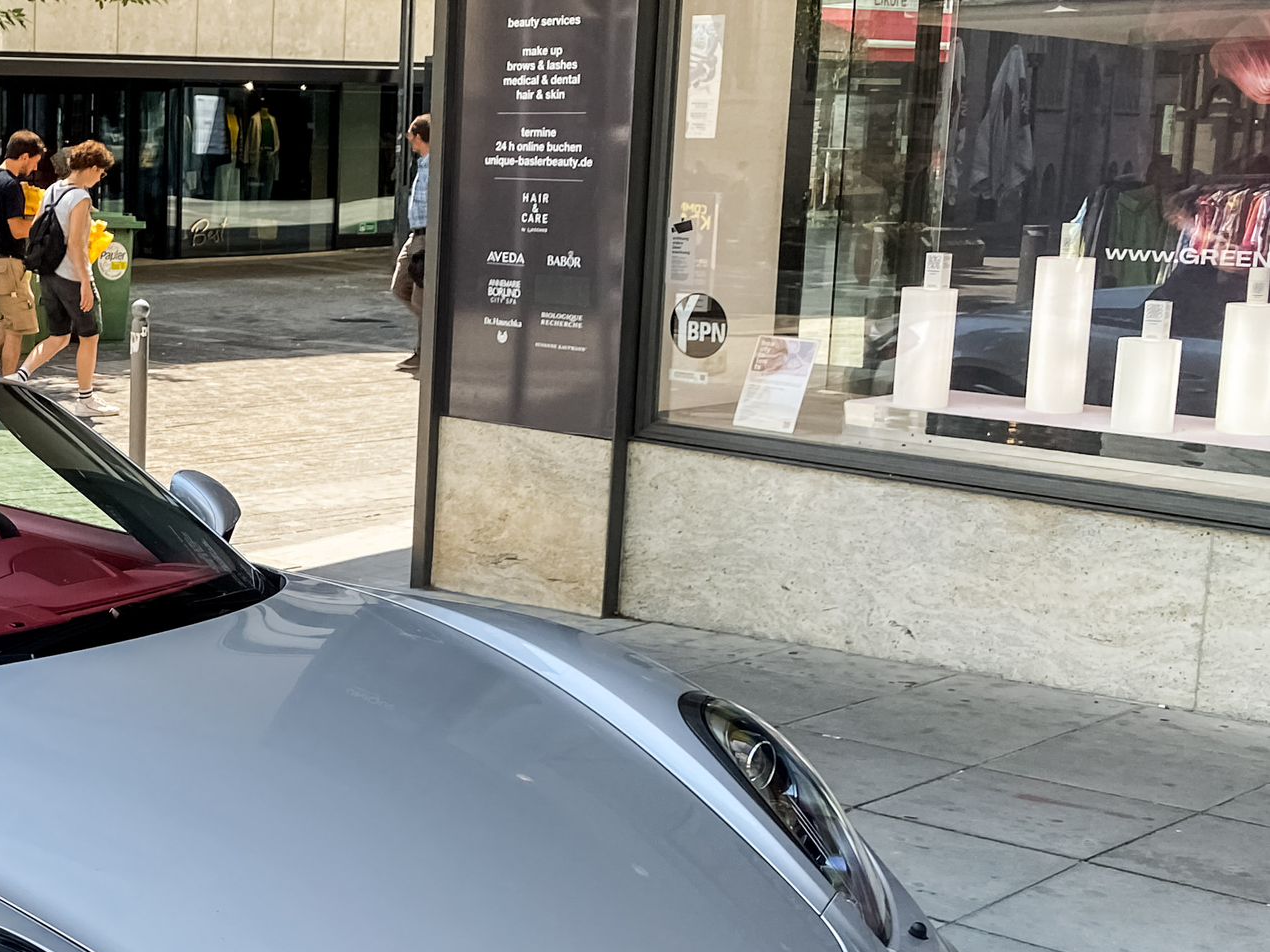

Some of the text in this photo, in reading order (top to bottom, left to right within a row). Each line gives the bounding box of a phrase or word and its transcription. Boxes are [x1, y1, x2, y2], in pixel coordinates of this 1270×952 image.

[507, 14, 581, 29] beauty services
[522, 45, 563, 57] make up
[506, 59, 578, 71] brows & lashes
[502, 73, 581, 86] medical & dental
[516, 88, 566, 100] hair & skin
[520, 127, 557, 138] termine
[495, 141, 583, 153] 24 h online buchen
[484, 155, 593, 169] unique-baslerbeauty.de
[522, 192, 550, 204] HAIR
[531, 203, 539, 213] &
[521, 212, 549, 224] CARE
[191, 217, 228, 247] Best
[486, 250, 525, 265] AVEDA
